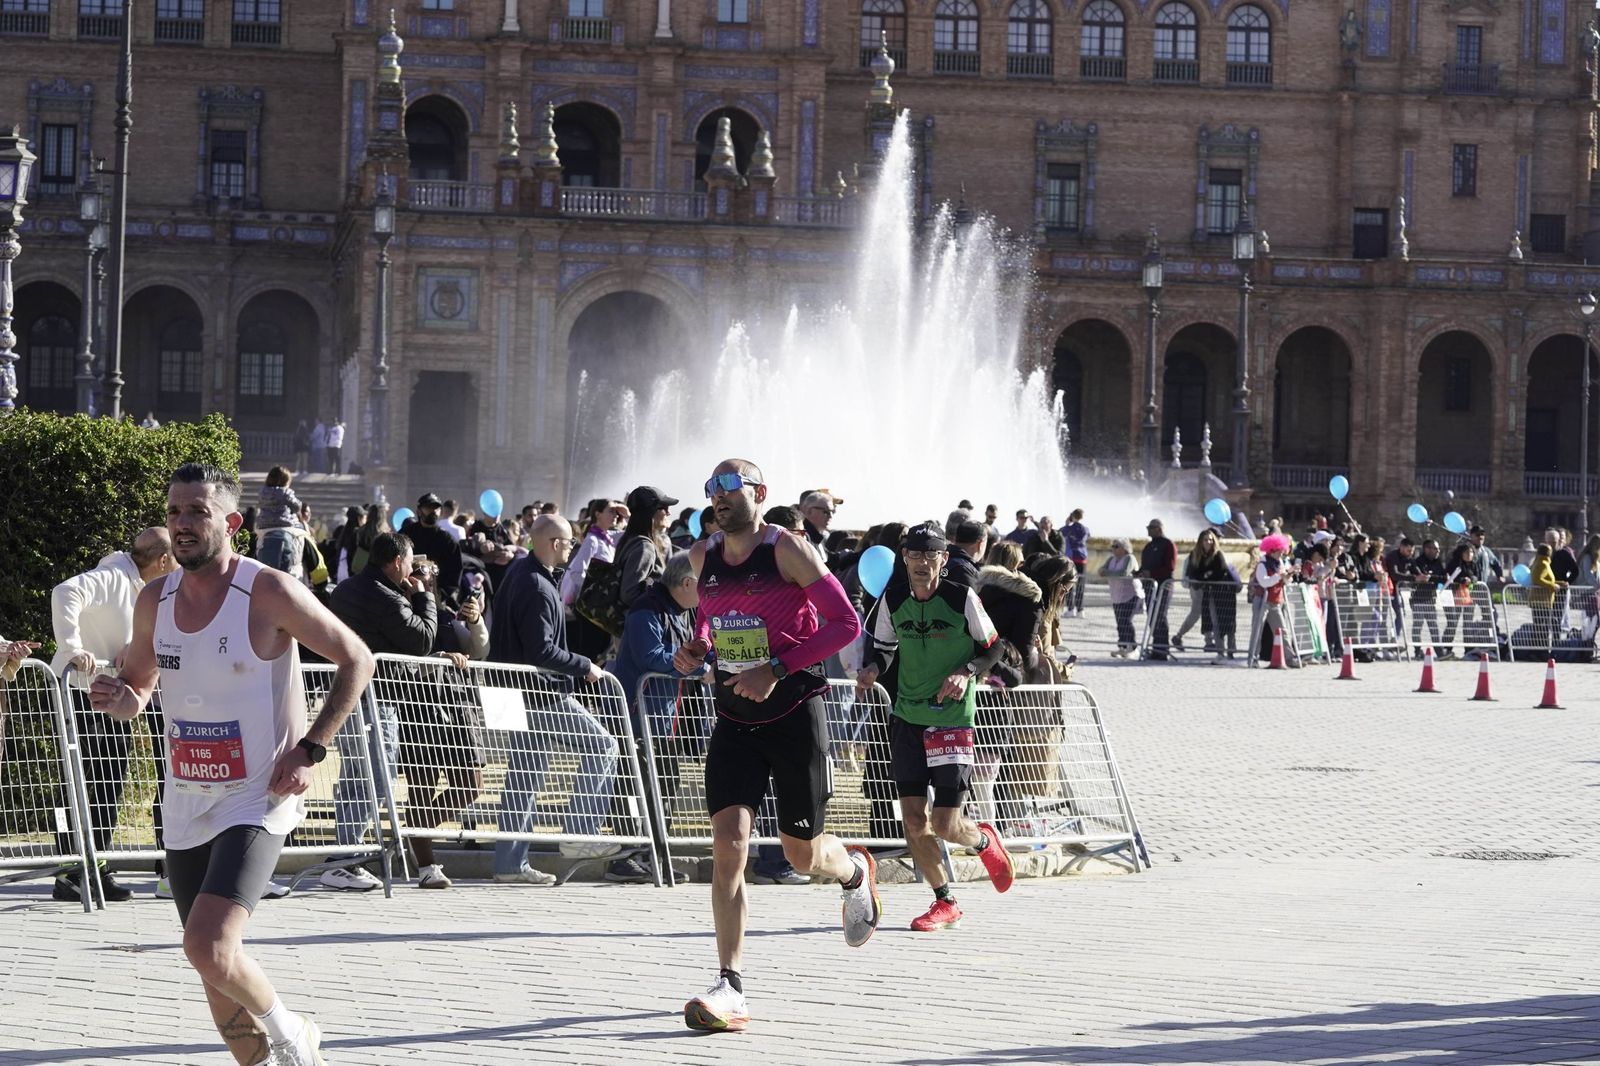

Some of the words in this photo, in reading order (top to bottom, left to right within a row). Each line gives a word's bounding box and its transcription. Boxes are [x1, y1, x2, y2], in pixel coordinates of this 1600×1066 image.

[724, 618, 759, 628] ZURICH
[727, 636, 745, 645] 1963
[186, 726, 229, 737] ZURICH
[190, 748, 212, 759] 1165
[926, 747, 944, 756] NUNO
[945, 745, 973, 754] OLIVEIRA
[180, 761, 230, 779] MARCO
